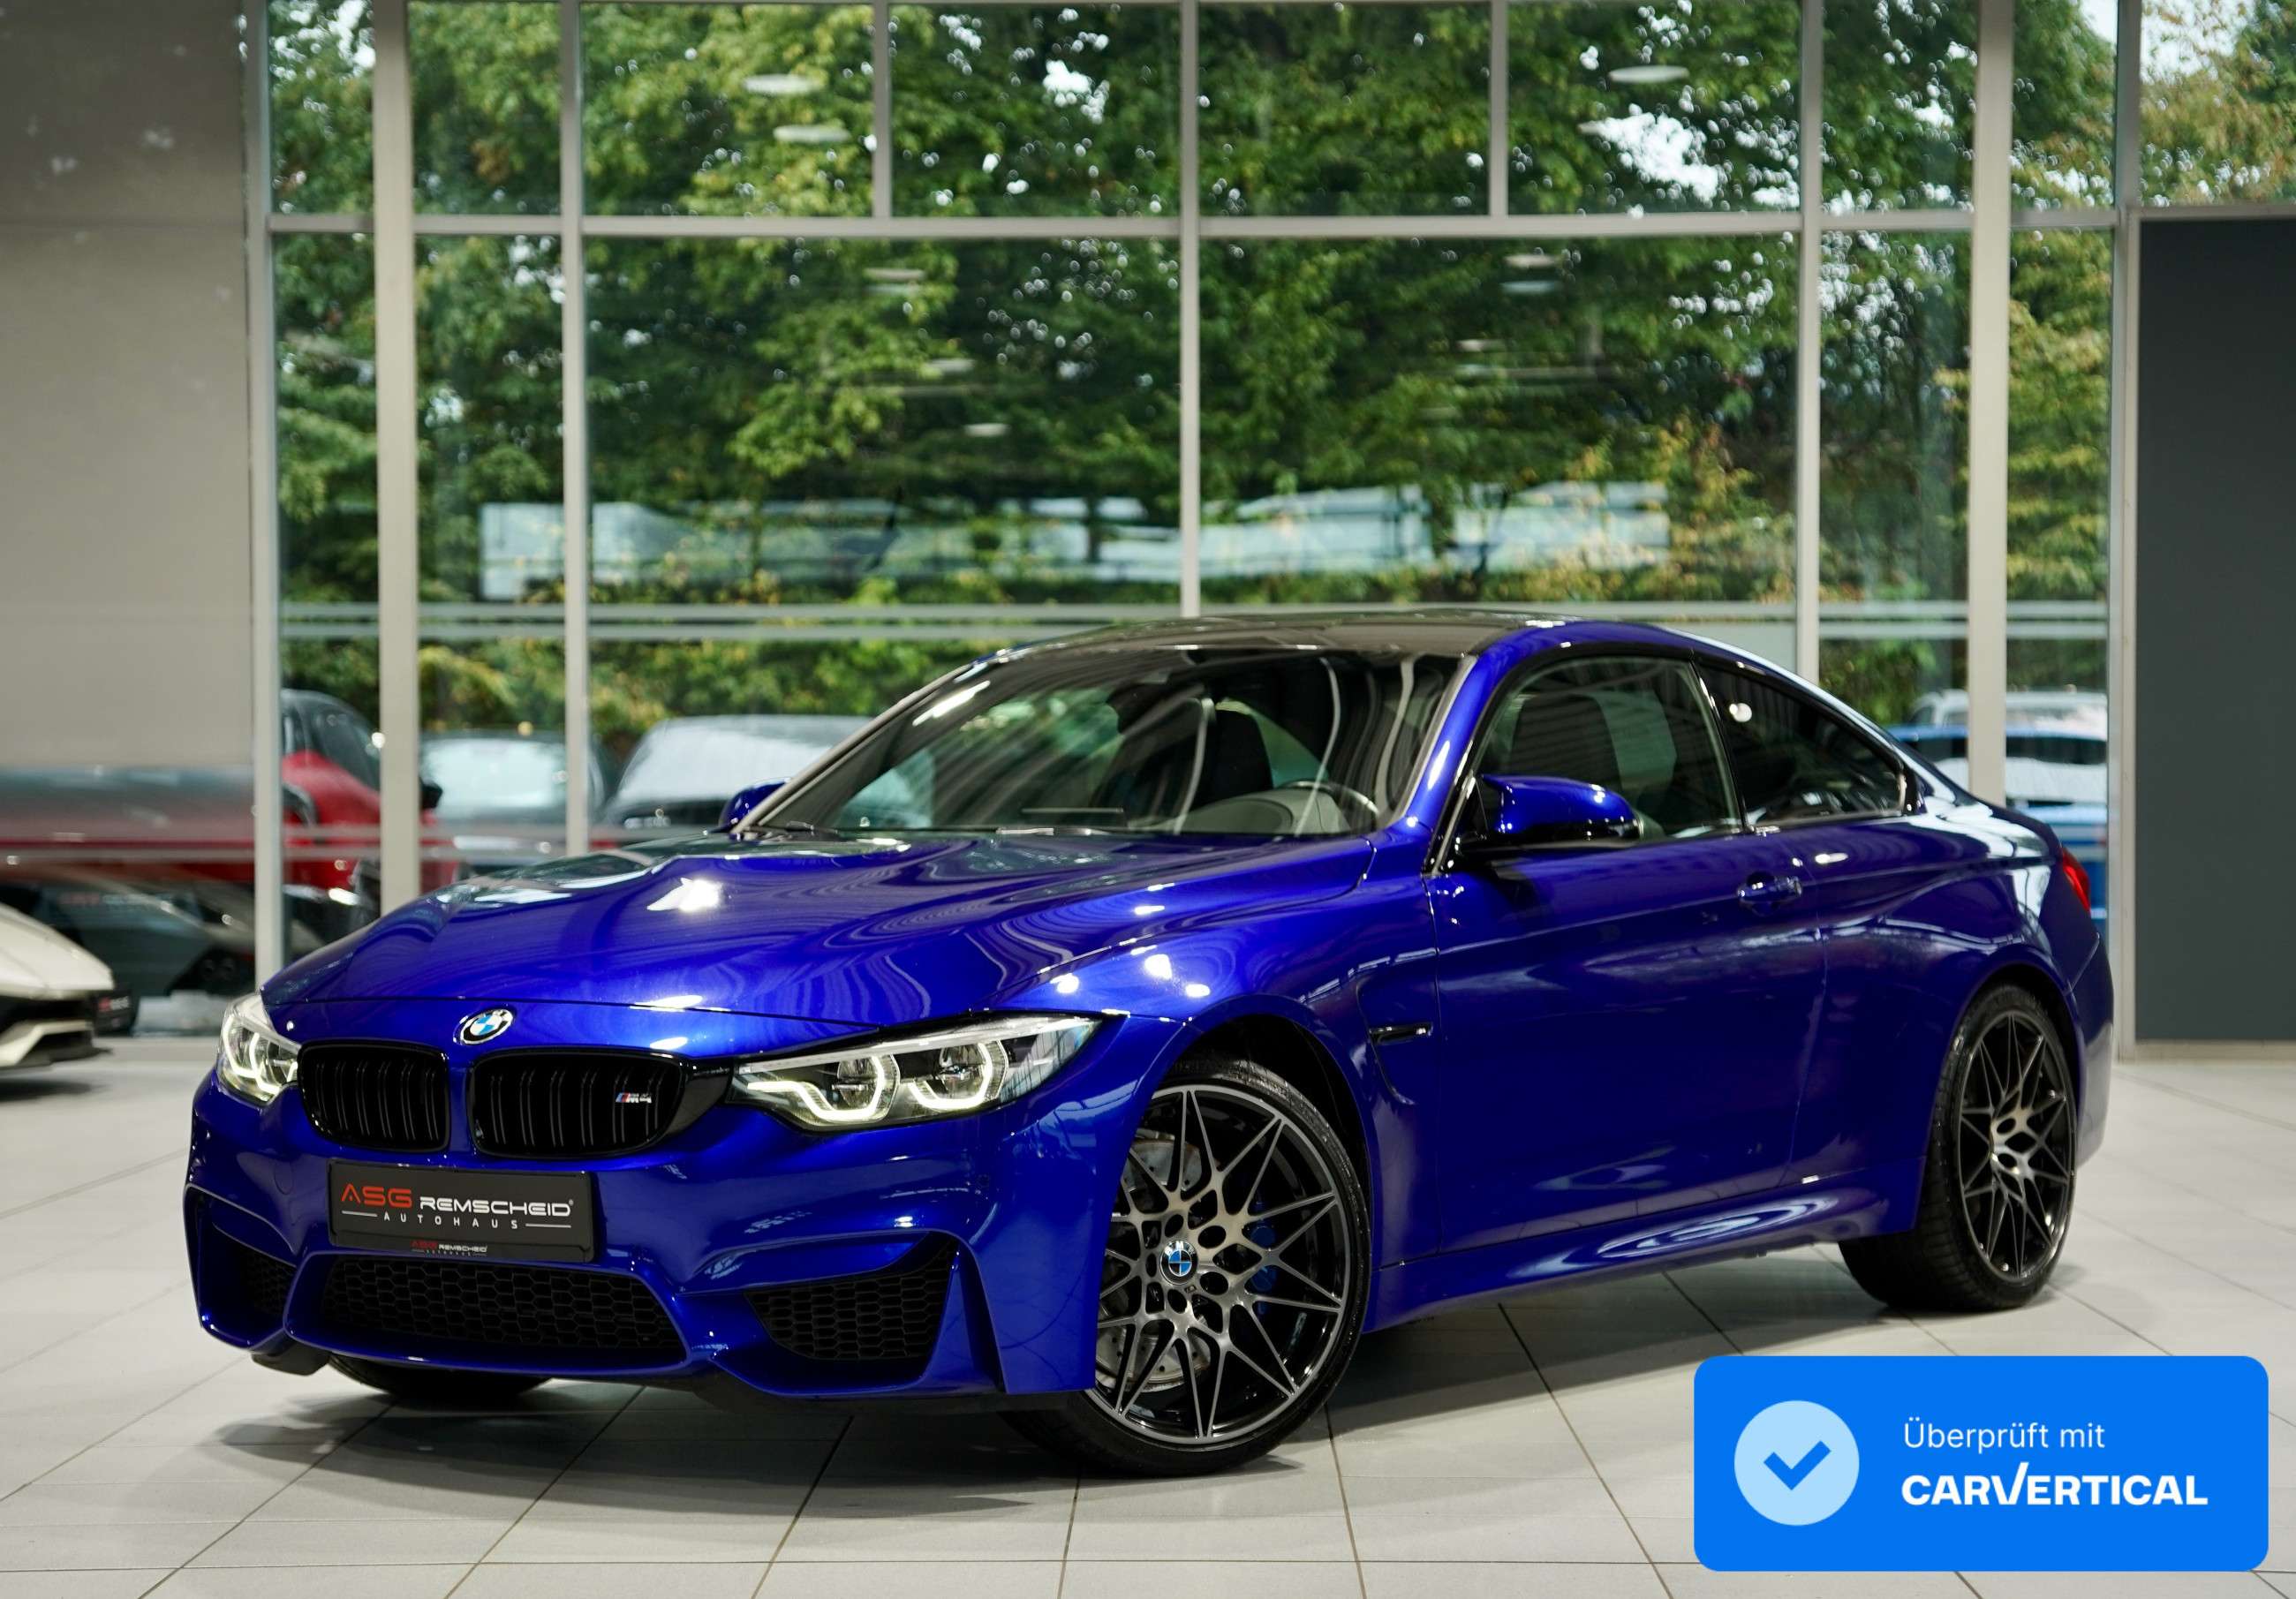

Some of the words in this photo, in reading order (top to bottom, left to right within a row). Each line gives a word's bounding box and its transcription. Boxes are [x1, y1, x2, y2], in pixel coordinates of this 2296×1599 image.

[625, 1092, 653, 1104] M4
[341, 1182, 412, 1209] ASG
[419, 1195, 571, 1217] REMSCHEID
[383, 1211, 518, 1230] AUTOHAUS
